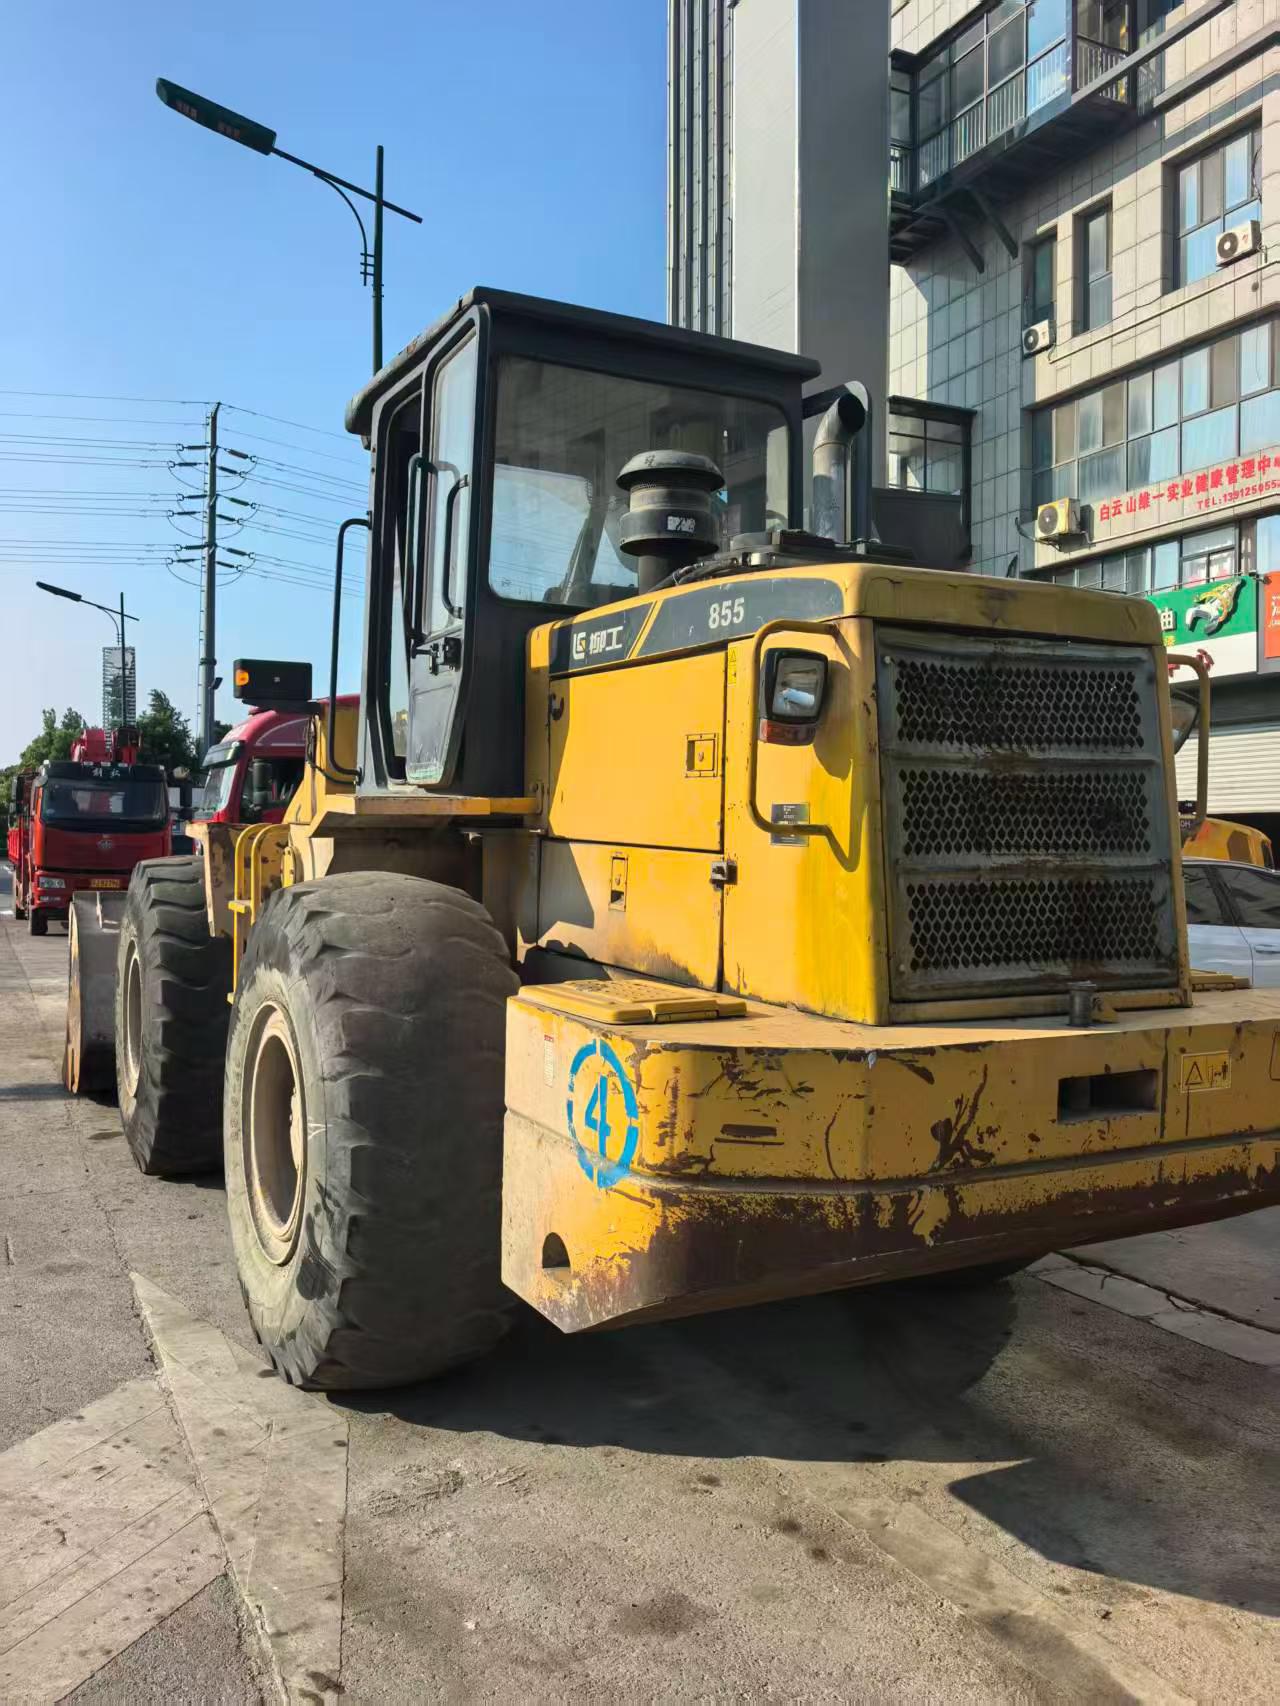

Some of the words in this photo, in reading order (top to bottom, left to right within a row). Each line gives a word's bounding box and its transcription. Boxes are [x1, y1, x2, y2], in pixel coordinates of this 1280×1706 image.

[708, 597, 745, 629] 855
[589, 625, 624, 655] 柳工
[584, 1074, 611, 1161] 4
